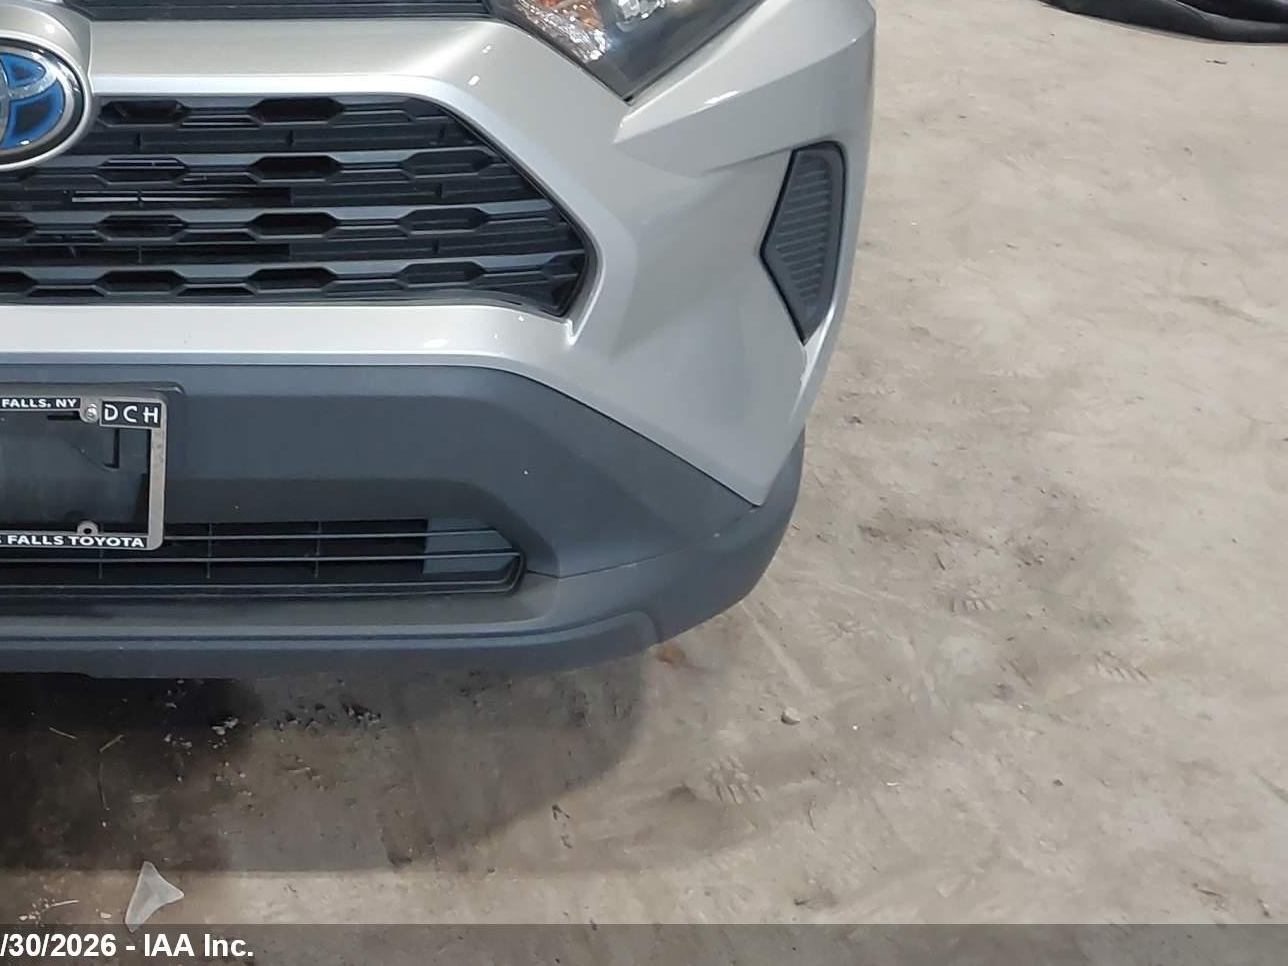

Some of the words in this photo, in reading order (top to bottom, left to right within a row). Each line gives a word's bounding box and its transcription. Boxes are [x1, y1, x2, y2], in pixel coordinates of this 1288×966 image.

[56, 397, 77, 409] NY
[104, 404, 159, 424] DCH
[7, 535, 64, 547] FALLS
[68, 535, 145, 548] TOYOTA
